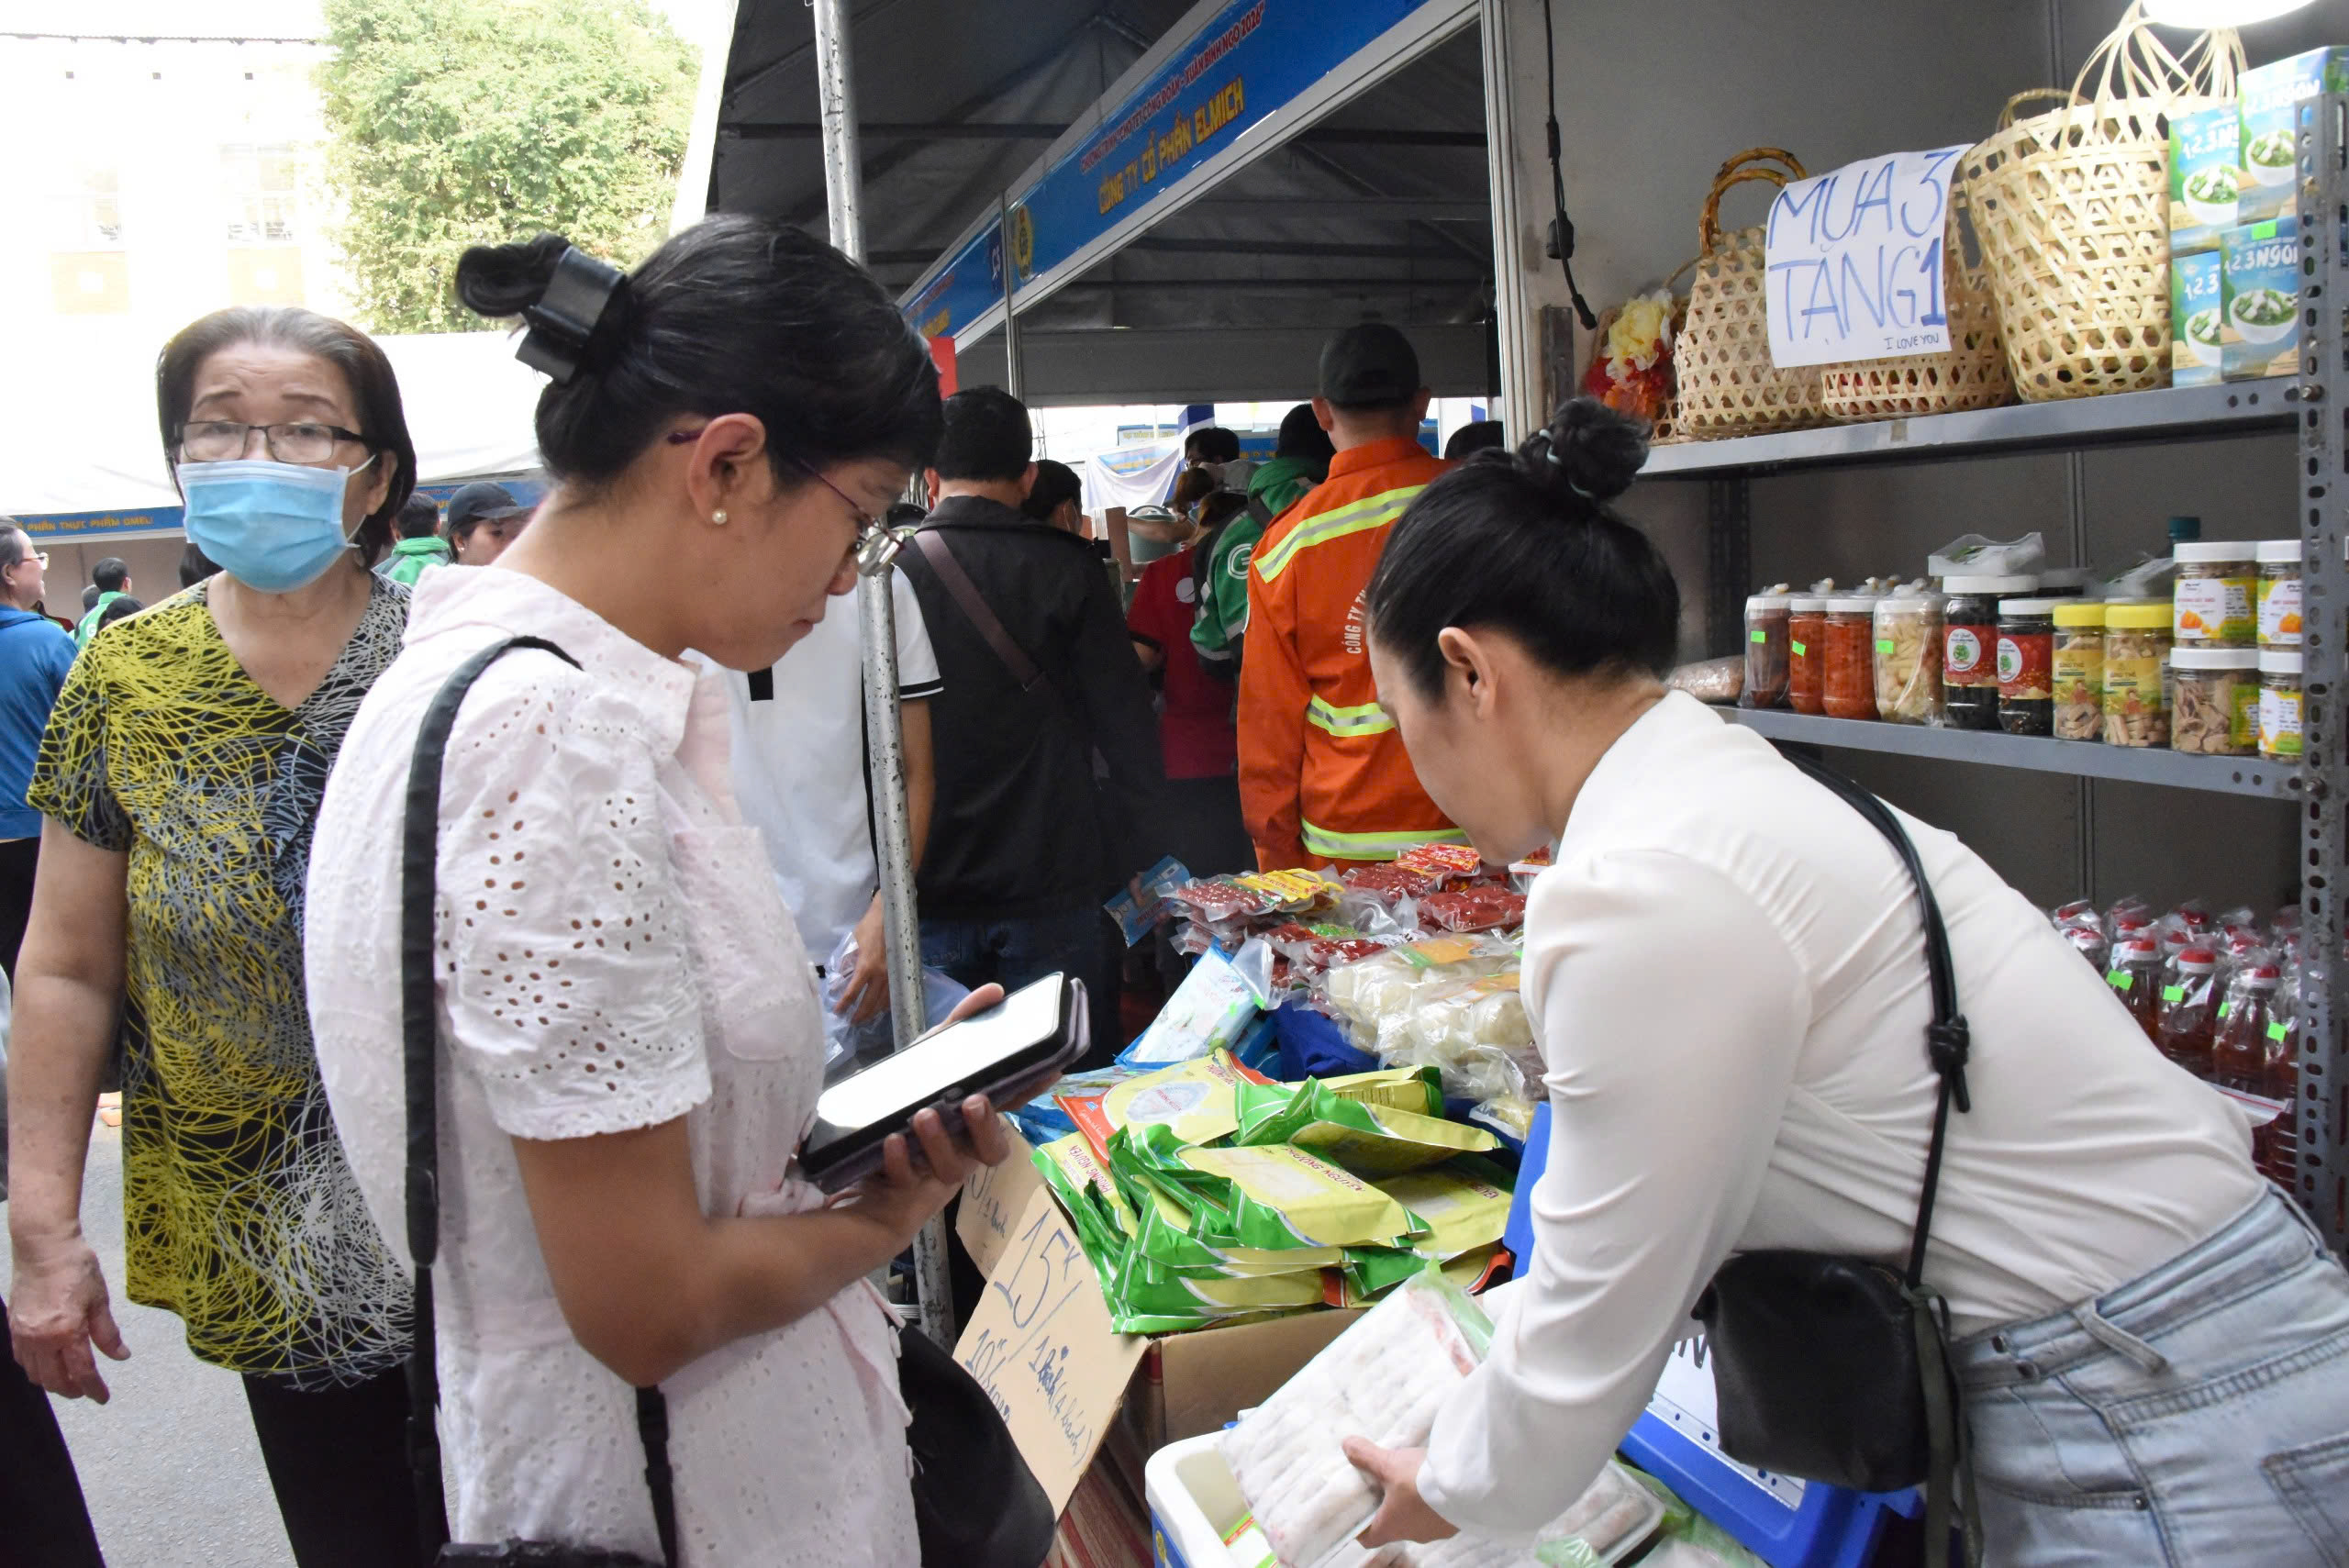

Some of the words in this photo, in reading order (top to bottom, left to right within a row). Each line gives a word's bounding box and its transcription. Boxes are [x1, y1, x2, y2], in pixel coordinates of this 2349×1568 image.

[1194, 73, 1245, 148] ELMICH
[1768, 160, 1896, 250] MUA
[1900, 150, 1960, 239] 3
[1919, 237, 1947, 327] 1
[1884, 338, 1894, 350] I
[1896, 336, 1920, 350] LOVE
[1921, 333, 1940, 346] YOU
